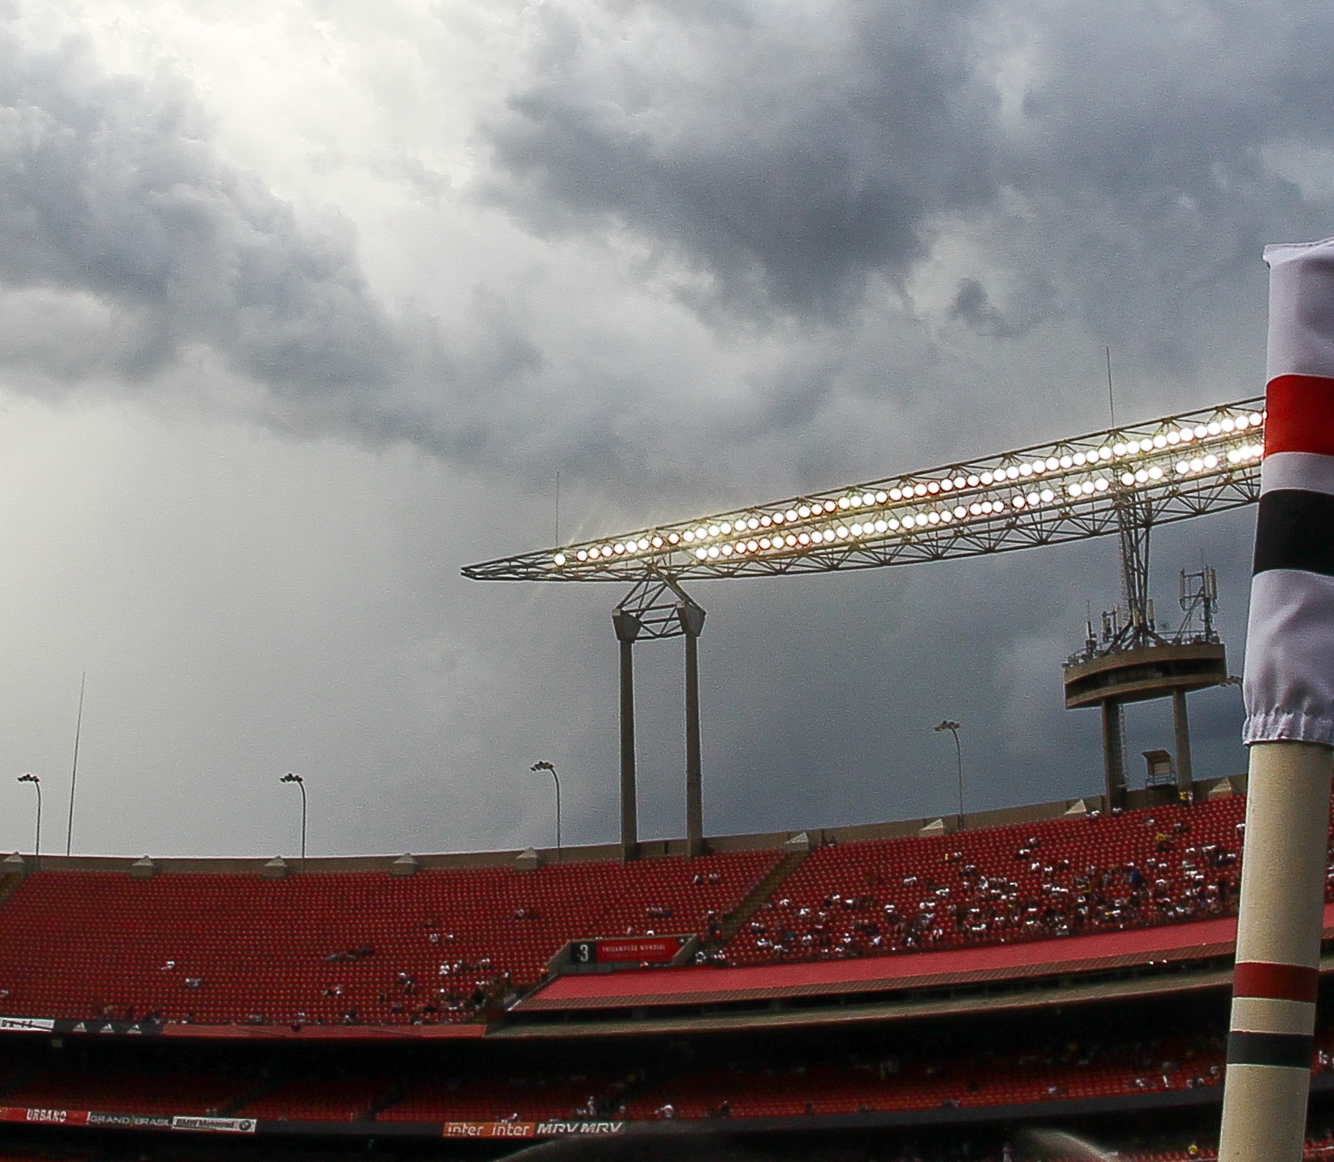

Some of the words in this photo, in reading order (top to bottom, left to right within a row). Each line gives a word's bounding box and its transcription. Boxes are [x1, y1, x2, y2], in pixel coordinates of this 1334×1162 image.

[579, 944, 589, 962] 3
[447, 1122, 484, 1137] inter
[492, 1122, 530, 1137] inter
[537, 1122, 579, 1134] MRV
[580, 1121, 624, 1134] MRV
